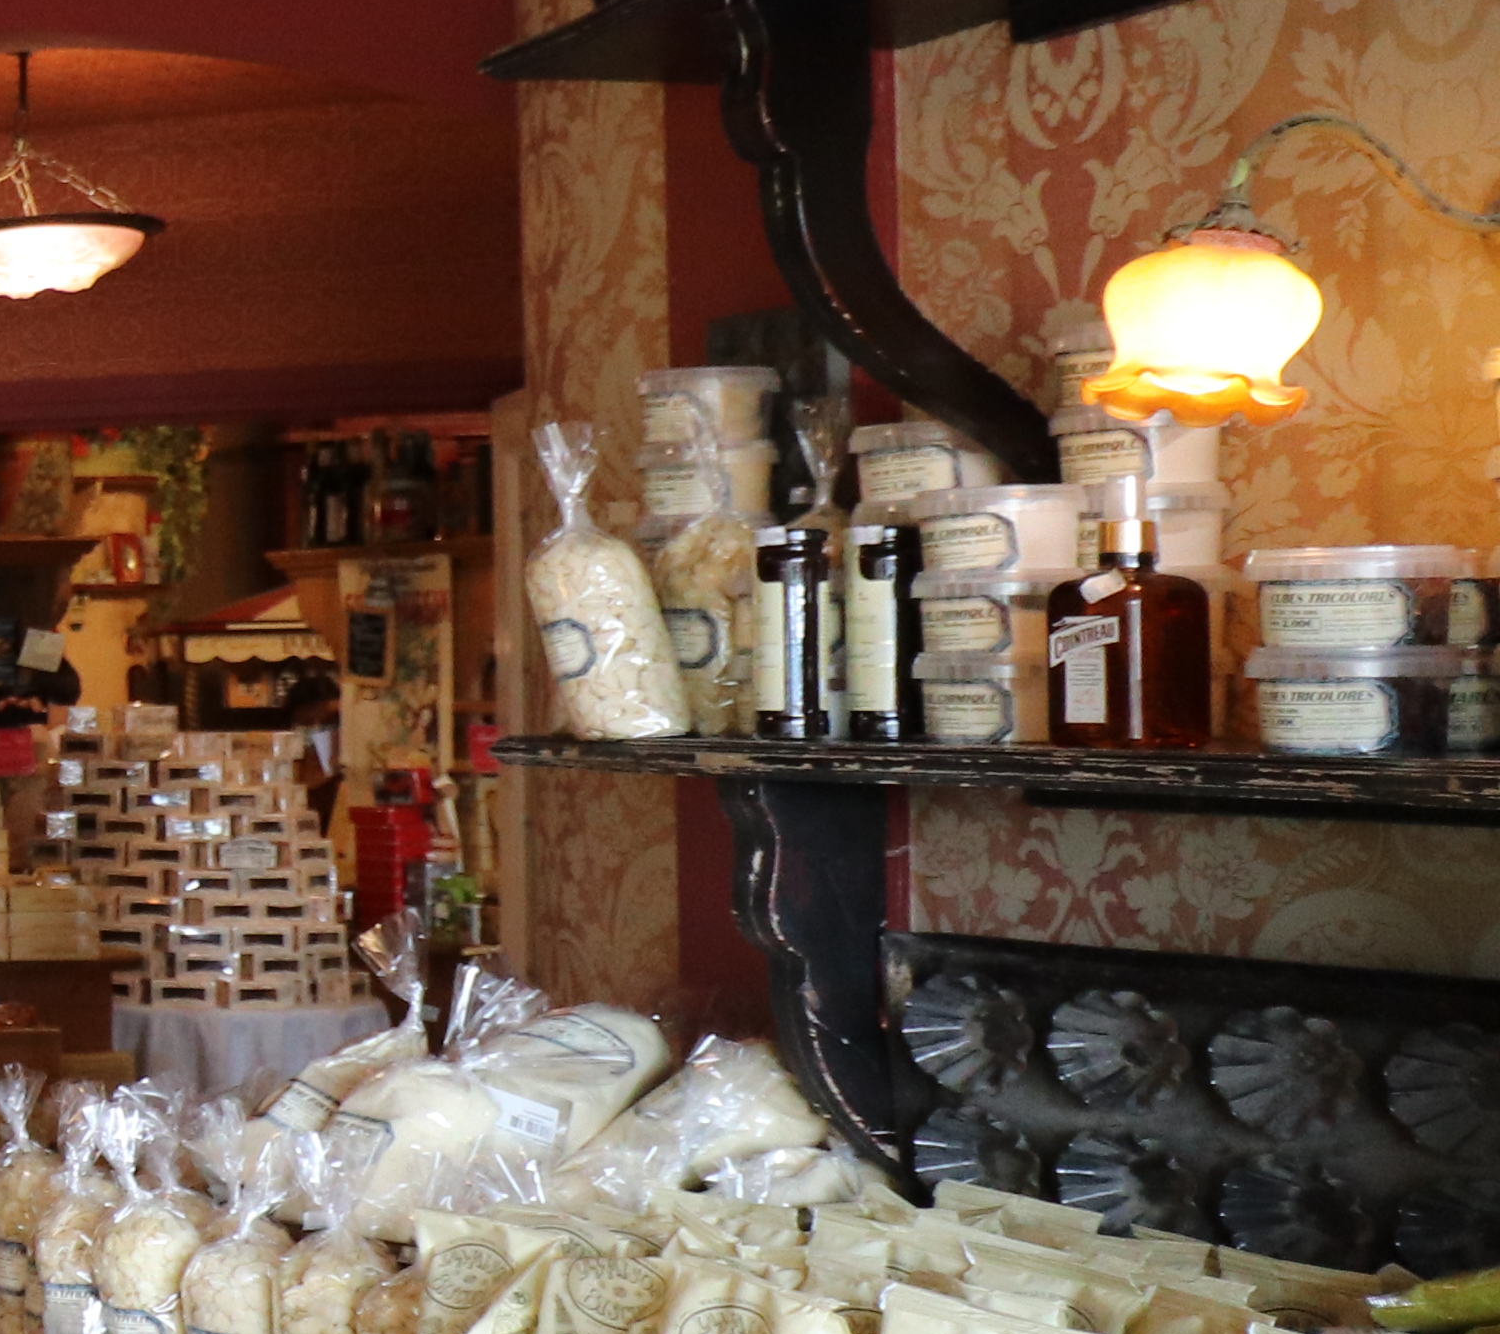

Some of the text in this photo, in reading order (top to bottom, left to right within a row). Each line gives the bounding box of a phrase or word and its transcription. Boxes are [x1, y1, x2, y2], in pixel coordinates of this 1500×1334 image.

[1307, 590, 1396, 603] TRICOLORES
[1053, 622, 1116, 659] COINTREAU
[1290, 690, 1375, 702] TRICOLORES
